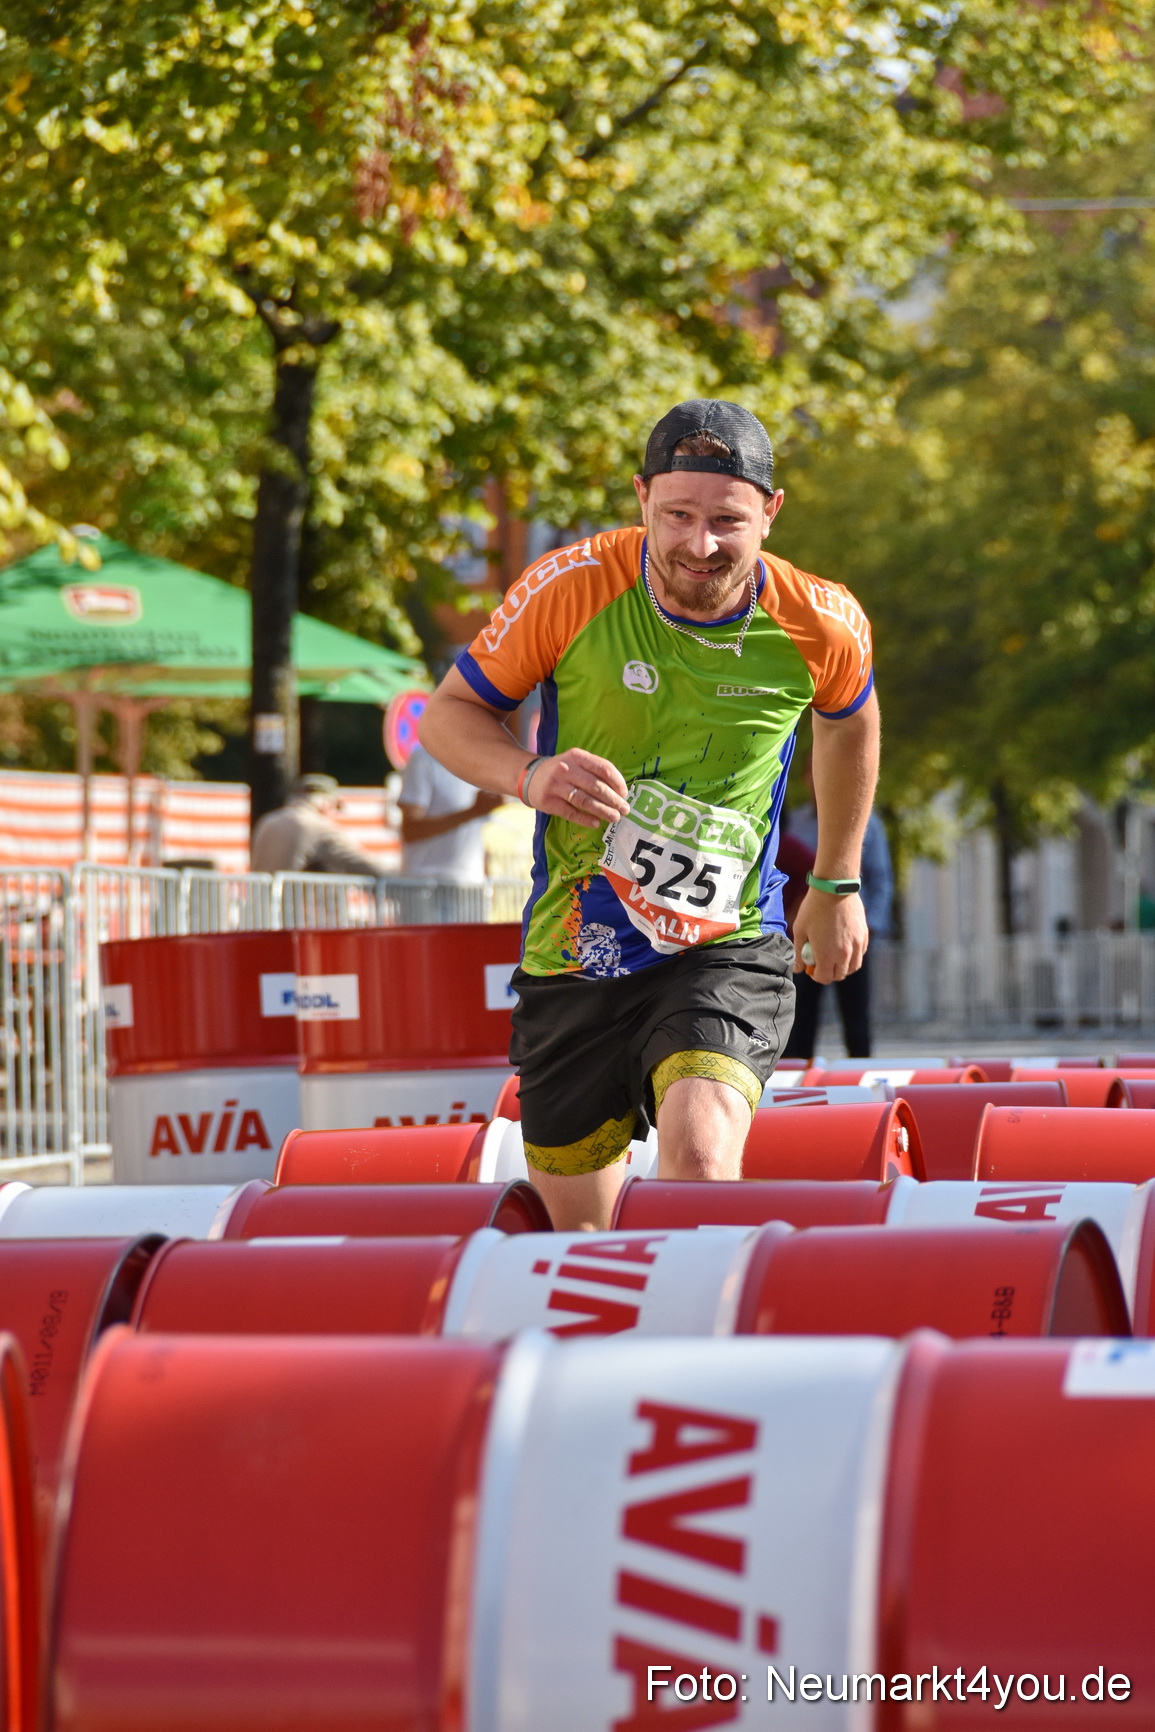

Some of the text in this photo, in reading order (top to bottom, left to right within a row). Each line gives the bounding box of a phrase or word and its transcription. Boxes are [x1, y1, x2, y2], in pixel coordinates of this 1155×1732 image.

[481, 541, 601, 653] BOCK
[630, 783, 747, 855] BOCK
[629, 838, 722, 908] 525
